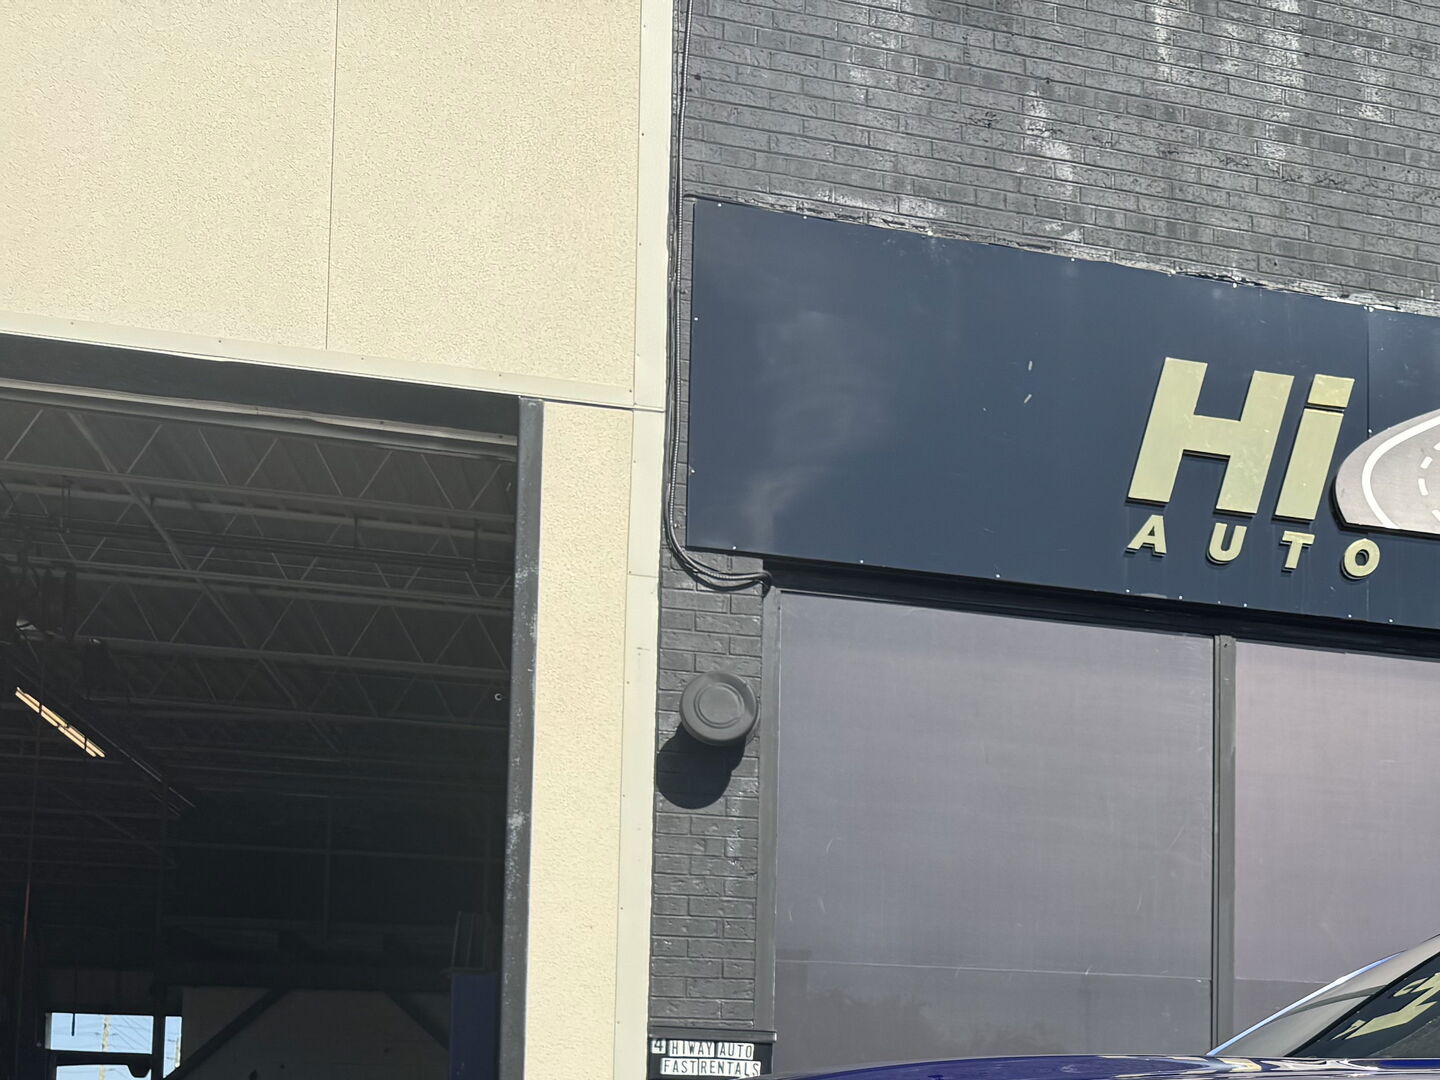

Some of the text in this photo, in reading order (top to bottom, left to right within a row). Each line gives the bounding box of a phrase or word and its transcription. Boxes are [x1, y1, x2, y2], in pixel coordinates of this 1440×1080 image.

[1126, 515, 1381, 580] AUTO
[653, 1039, 753, 1058] 4 HIWAY AUTO
[663, 1060, 760, 1077] FAST RENTALS
